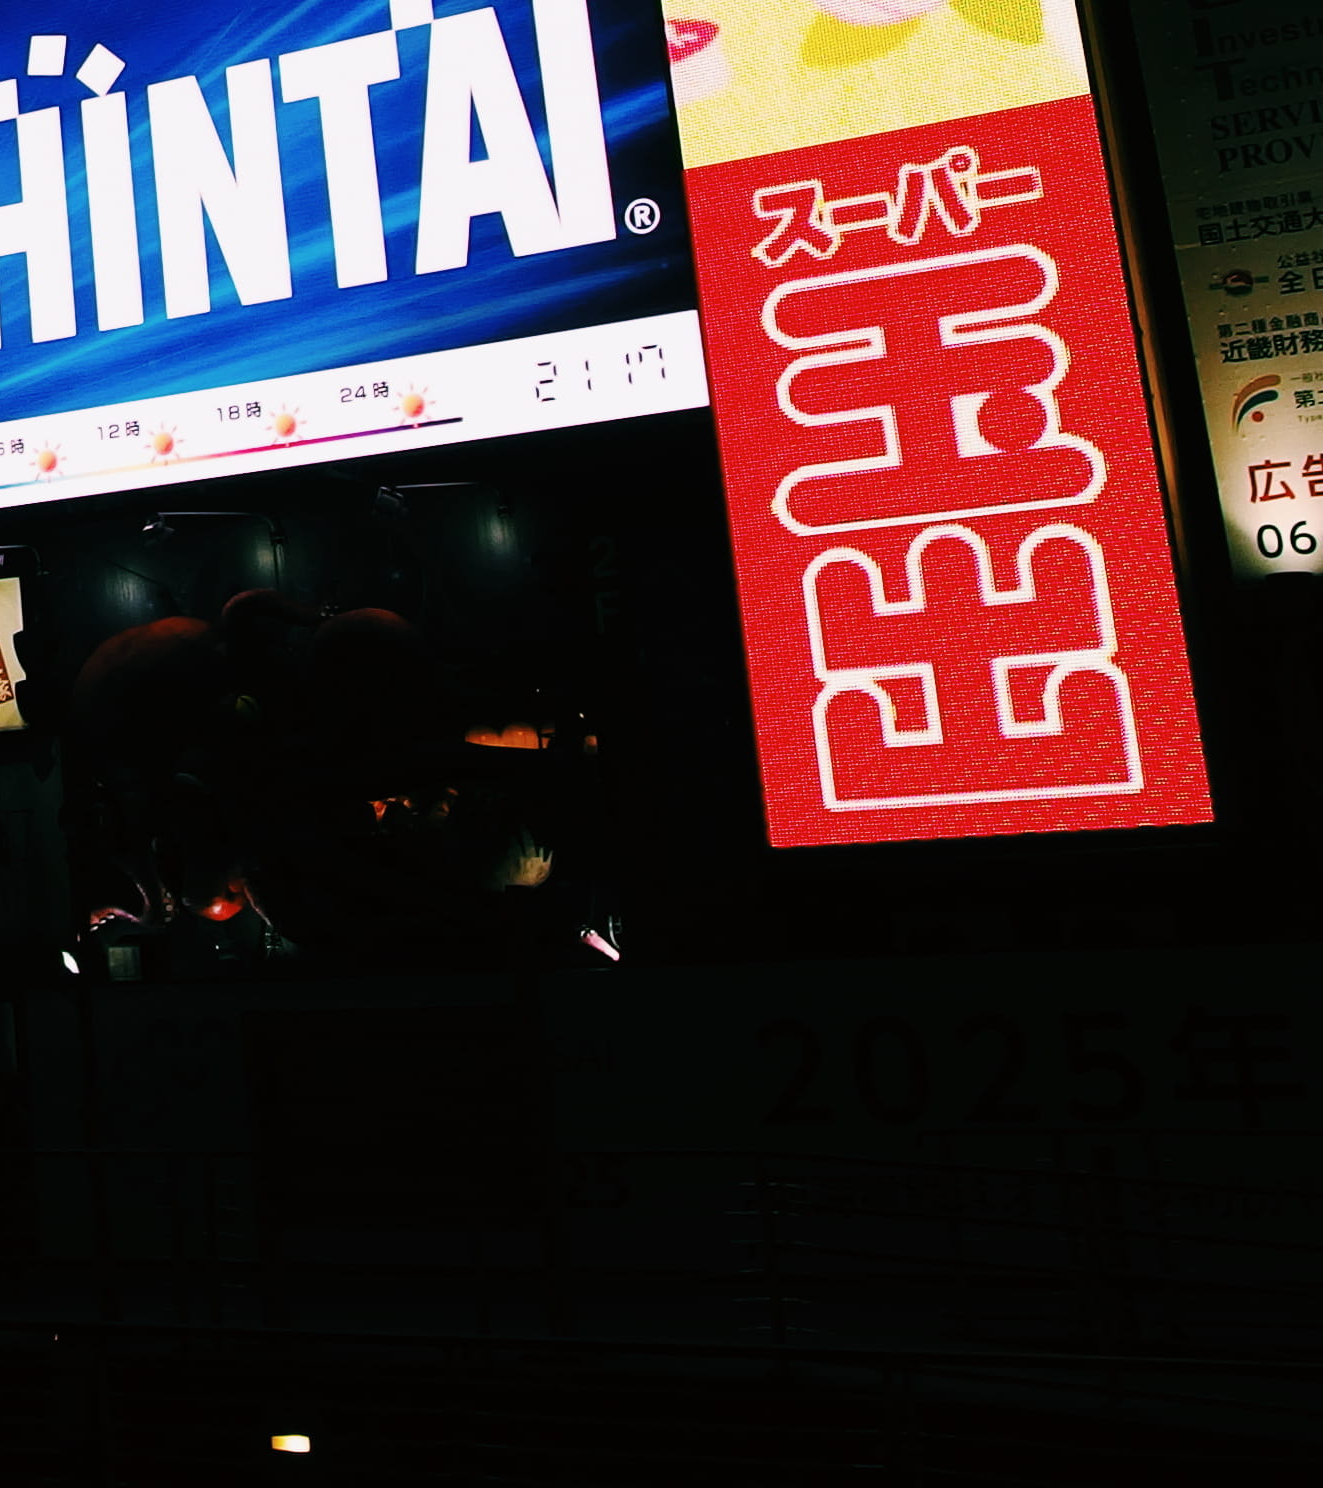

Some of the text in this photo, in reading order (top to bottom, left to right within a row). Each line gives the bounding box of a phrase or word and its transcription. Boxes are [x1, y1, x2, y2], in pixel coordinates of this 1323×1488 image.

[751, 145, 1045, 269] スーパー
[340, 380, 389, 404] 24時
[216, 401, 262, 424] 18時
[97, 420, 141, 440] 12時
[1257, 520, 1318, 559] 06
